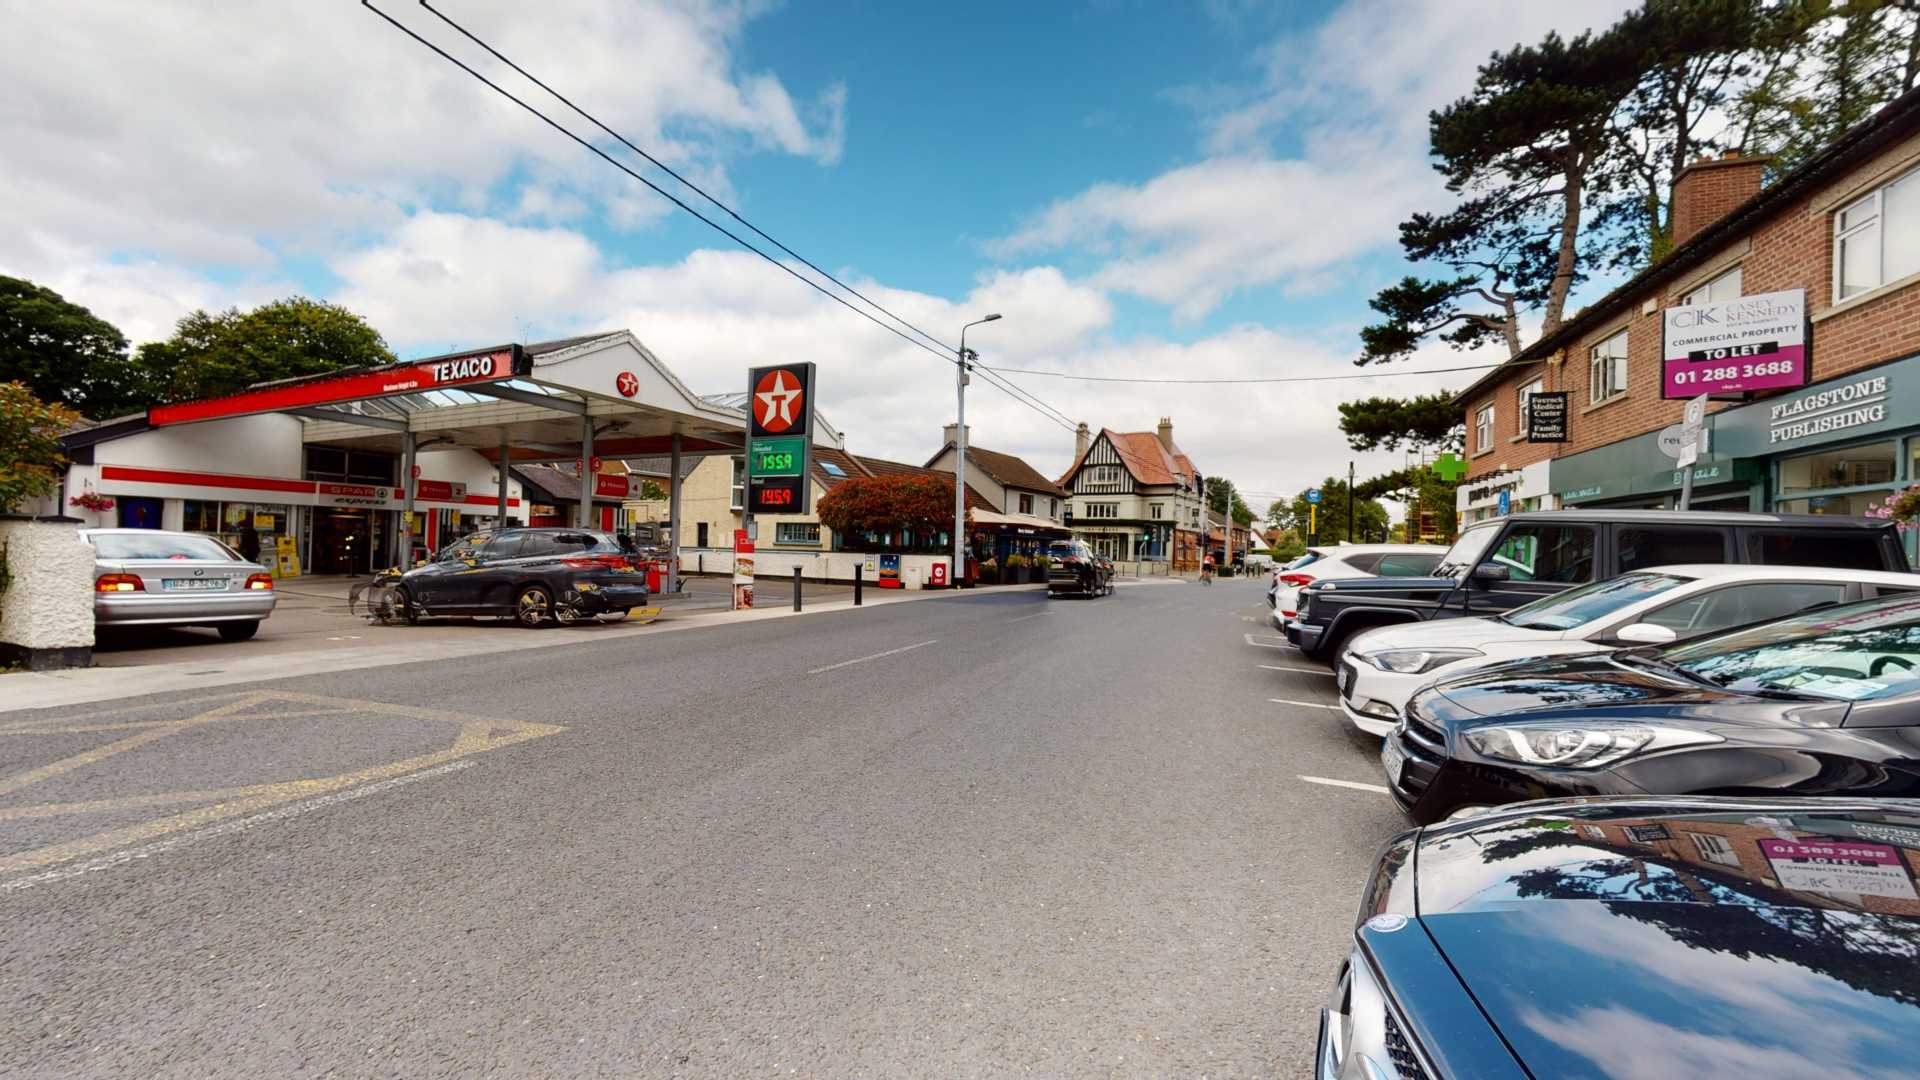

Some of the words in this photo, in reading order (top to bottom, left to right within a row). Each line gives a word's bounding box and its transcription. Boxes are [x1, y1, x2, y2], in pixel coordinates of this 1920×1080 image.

[1727, 304, 1798, 321] KENNEDY
[1672, 333, 1738, 347] COMMERCIAL
[1741, 324, 1798, 338] PROPERTY
[1704, 348, 1726, 360] TO
[1730, 344, 1762, 356] LET
[432, 356, 492, 382] TEXACO
[1674, 371, 1697, 384] 01
[1702, 366, 1738, 382] 288
[1742, 360, 1793, 378] 3688
[1771, 376, 1887, 420] FLAGSTONE
[1534, 424, 1562, 432] Family
[1769, 404, 1885, 443] PUBLISHING
[331, 487, 374, 497] SPAR
[1469, 486, 1489, 505] pure
